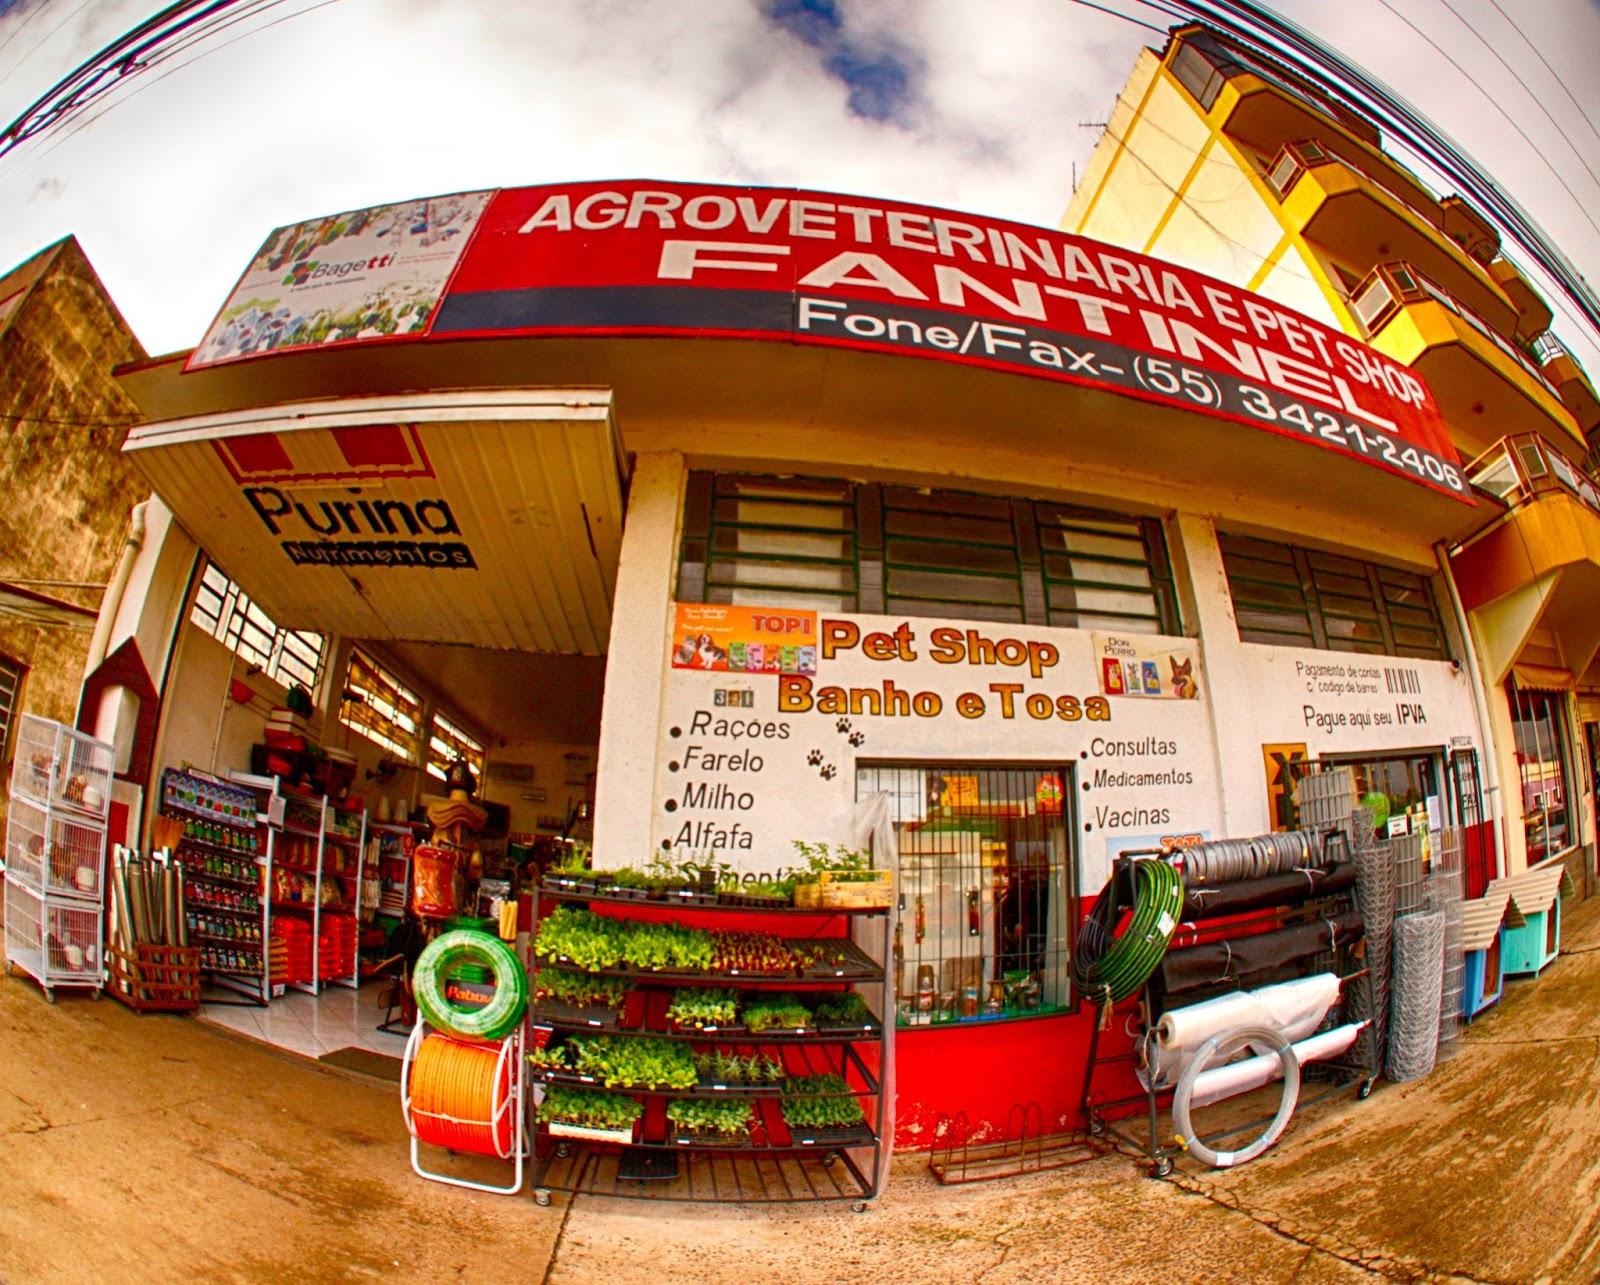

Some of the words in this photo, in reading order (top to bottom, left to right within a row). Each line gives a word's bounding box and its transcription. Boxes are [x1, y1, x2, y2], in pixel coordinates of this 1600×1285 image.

[311, 252, 398, 279] Bagetti
[518, 190, 1205, 319] AGROVETERINARIA
[1201, 284, 1249, 334] E
[1242, 299, 1334, 368] PET
[1336, 340, 1426, 410] SHOP
[656, 239, 1399, 433] FANTINEL
[1133, 353, 1223, 410] (55)
[1238, 384, 1464, 492] 3421-2406
[243, 486, 463, 537] Purina
[287, 543, 469, 565] Nutrimentos
[752, 613, 812, 635] TOPI
[821, 618, 918, 663] Pet
[929, 626, 1060, 679] Shop
[1295, 660, 1346, 681] Pagamento
[1347, 664, 1358, 679] de
[777, 674, 943, 718] Banho
[955, 691, 986, 720] e
[988, 682, 1112, 722] Tosa
[1346, 680, 1355, 693] de
[1302, 704, 1347, 735] Pague
[1348, 709, 1372, 731] aqui
[1373, 711, 1392, 725] seu
[1395, 703, 1428, 726] IPVA
[682, 745, 764, 773] Farelo
[1090, 736, 1178, 758] Consultas
[1093, 769, 1194, 789] Medicamentos
[681, 781, 755, 811] Milho
[1095, 806, 1171, 829] Vacinas
[673, 821, 754, 850] Alfafa
